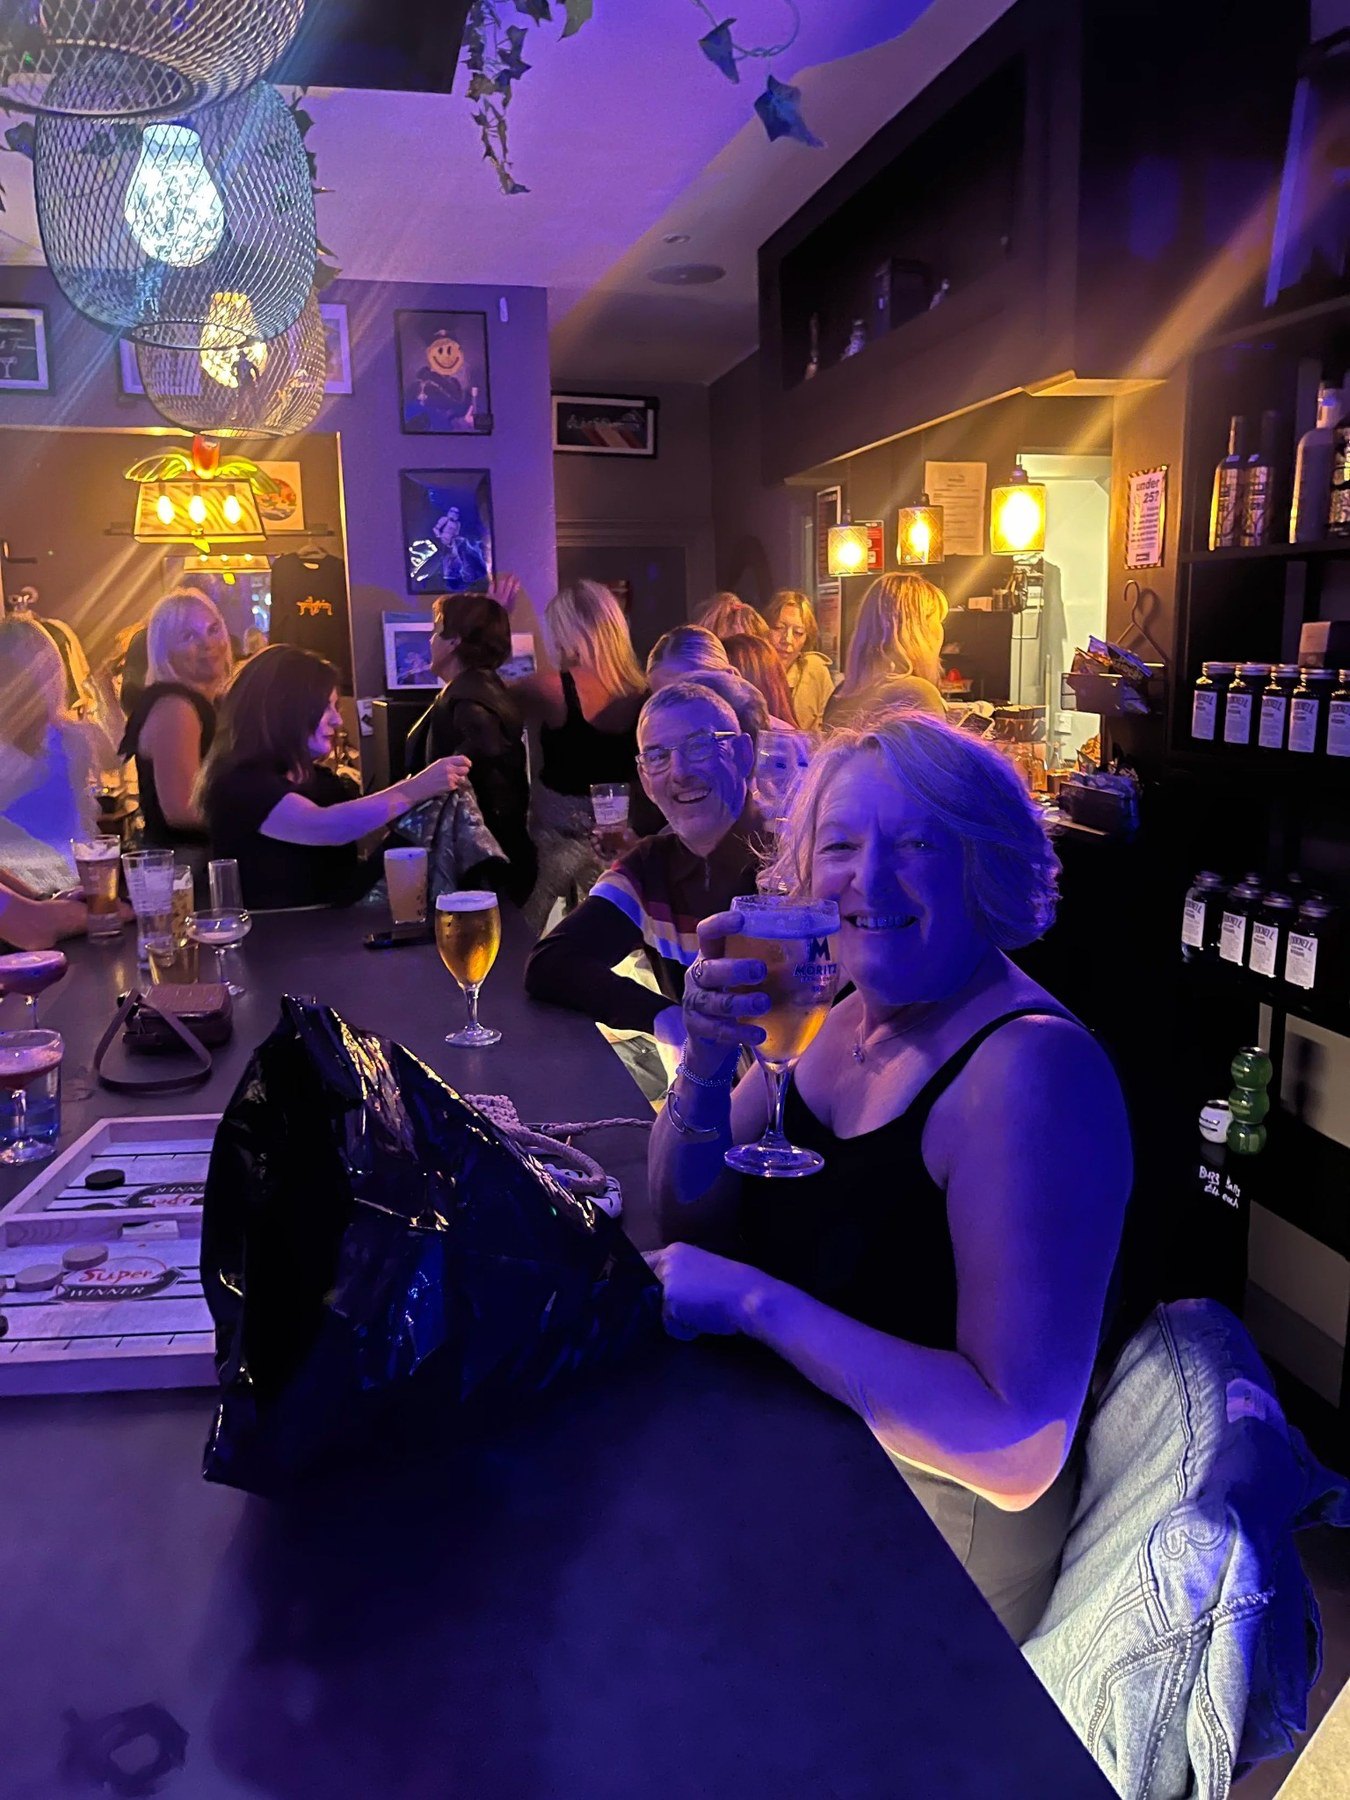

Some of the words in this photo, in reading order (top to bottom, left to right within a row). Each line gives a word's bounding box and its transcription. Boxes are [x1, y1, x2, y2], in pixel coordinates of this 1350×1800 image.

[1136, 478, 1160, 491] under
[79, 1268, 153, 1284] Super
[70, 1286, 145, 1297] WINNER
